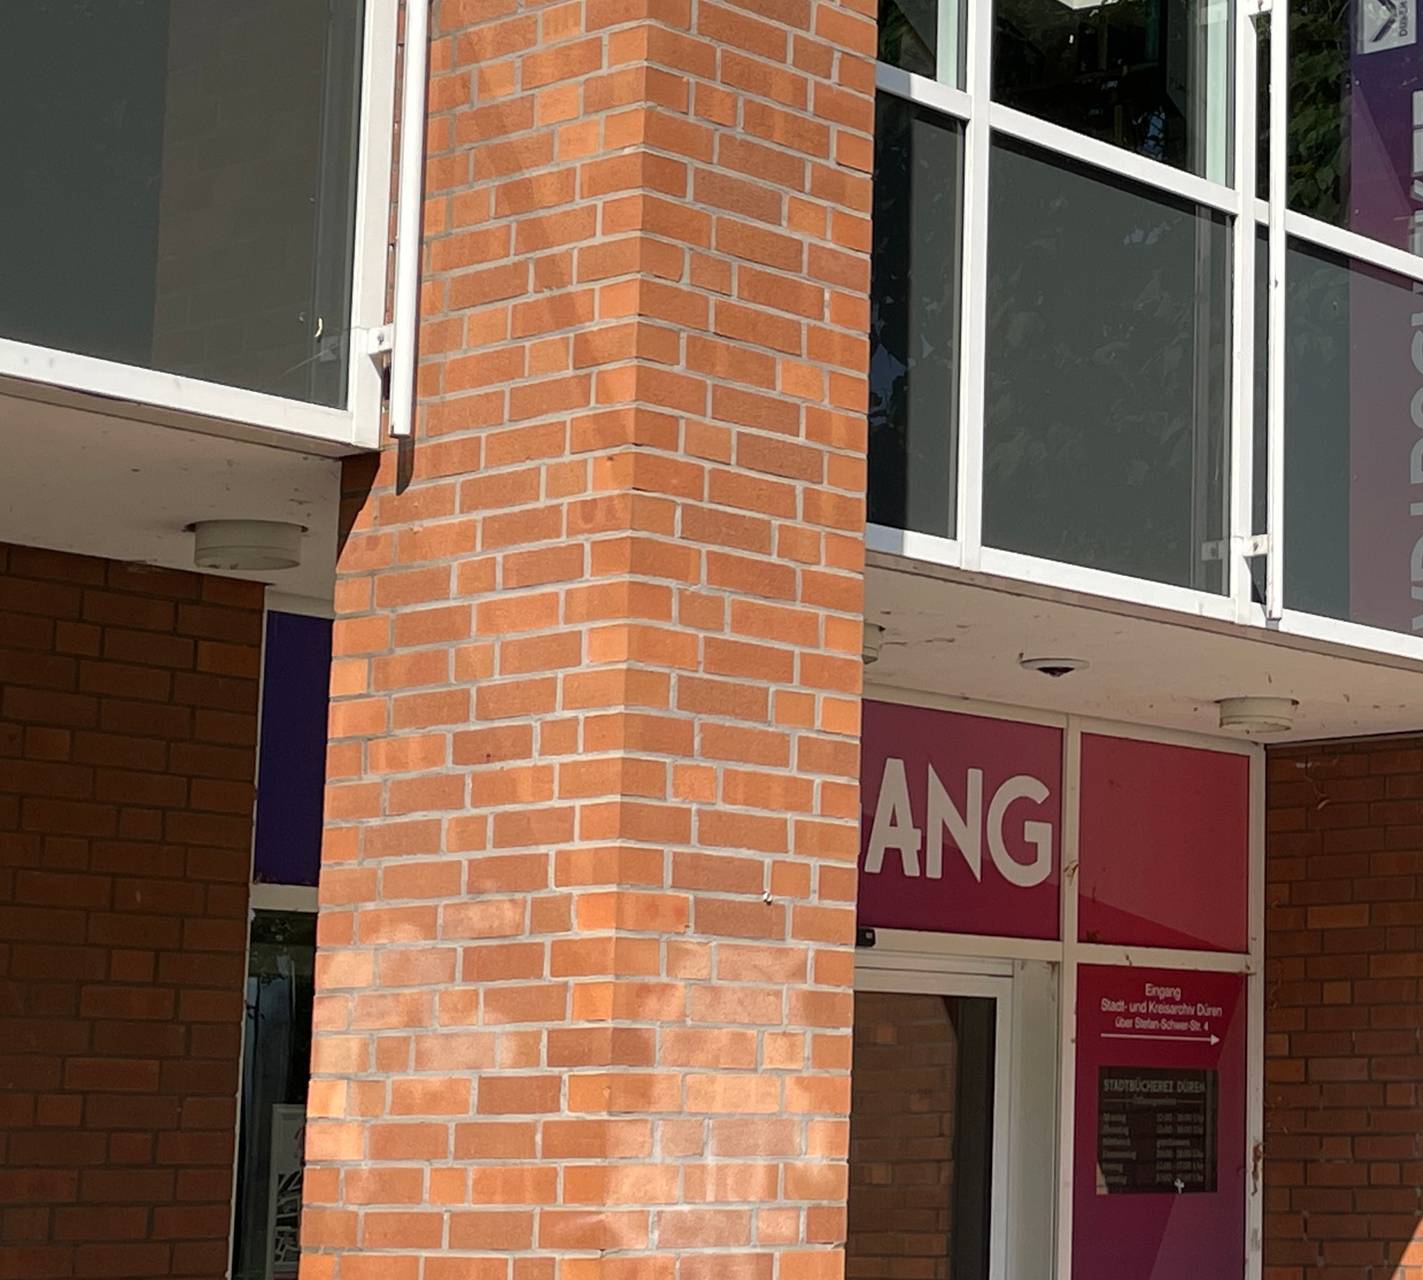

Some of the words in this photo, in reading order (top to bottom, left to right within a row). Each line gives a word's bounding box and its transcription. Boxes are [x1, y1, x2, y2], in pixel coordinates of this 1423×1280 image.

[864, 757, 1052, 887] ANG
[1145, 983, 1182, 1001] Eingang
[1101, 998, 1128, 1012] Stadt-
[1129, 1000, 1147, 1013] und
[1148, 1001, 1195, 1015] Kreisarchiv
[1197, 1003, 1223, 1016] Düren
[1203, 1021, 1208, 1031] 4
[1103, 1078, 1173, 1093] STADTBÜCHEREI
[1177, 1080, 1205, 1093] DÜREN
